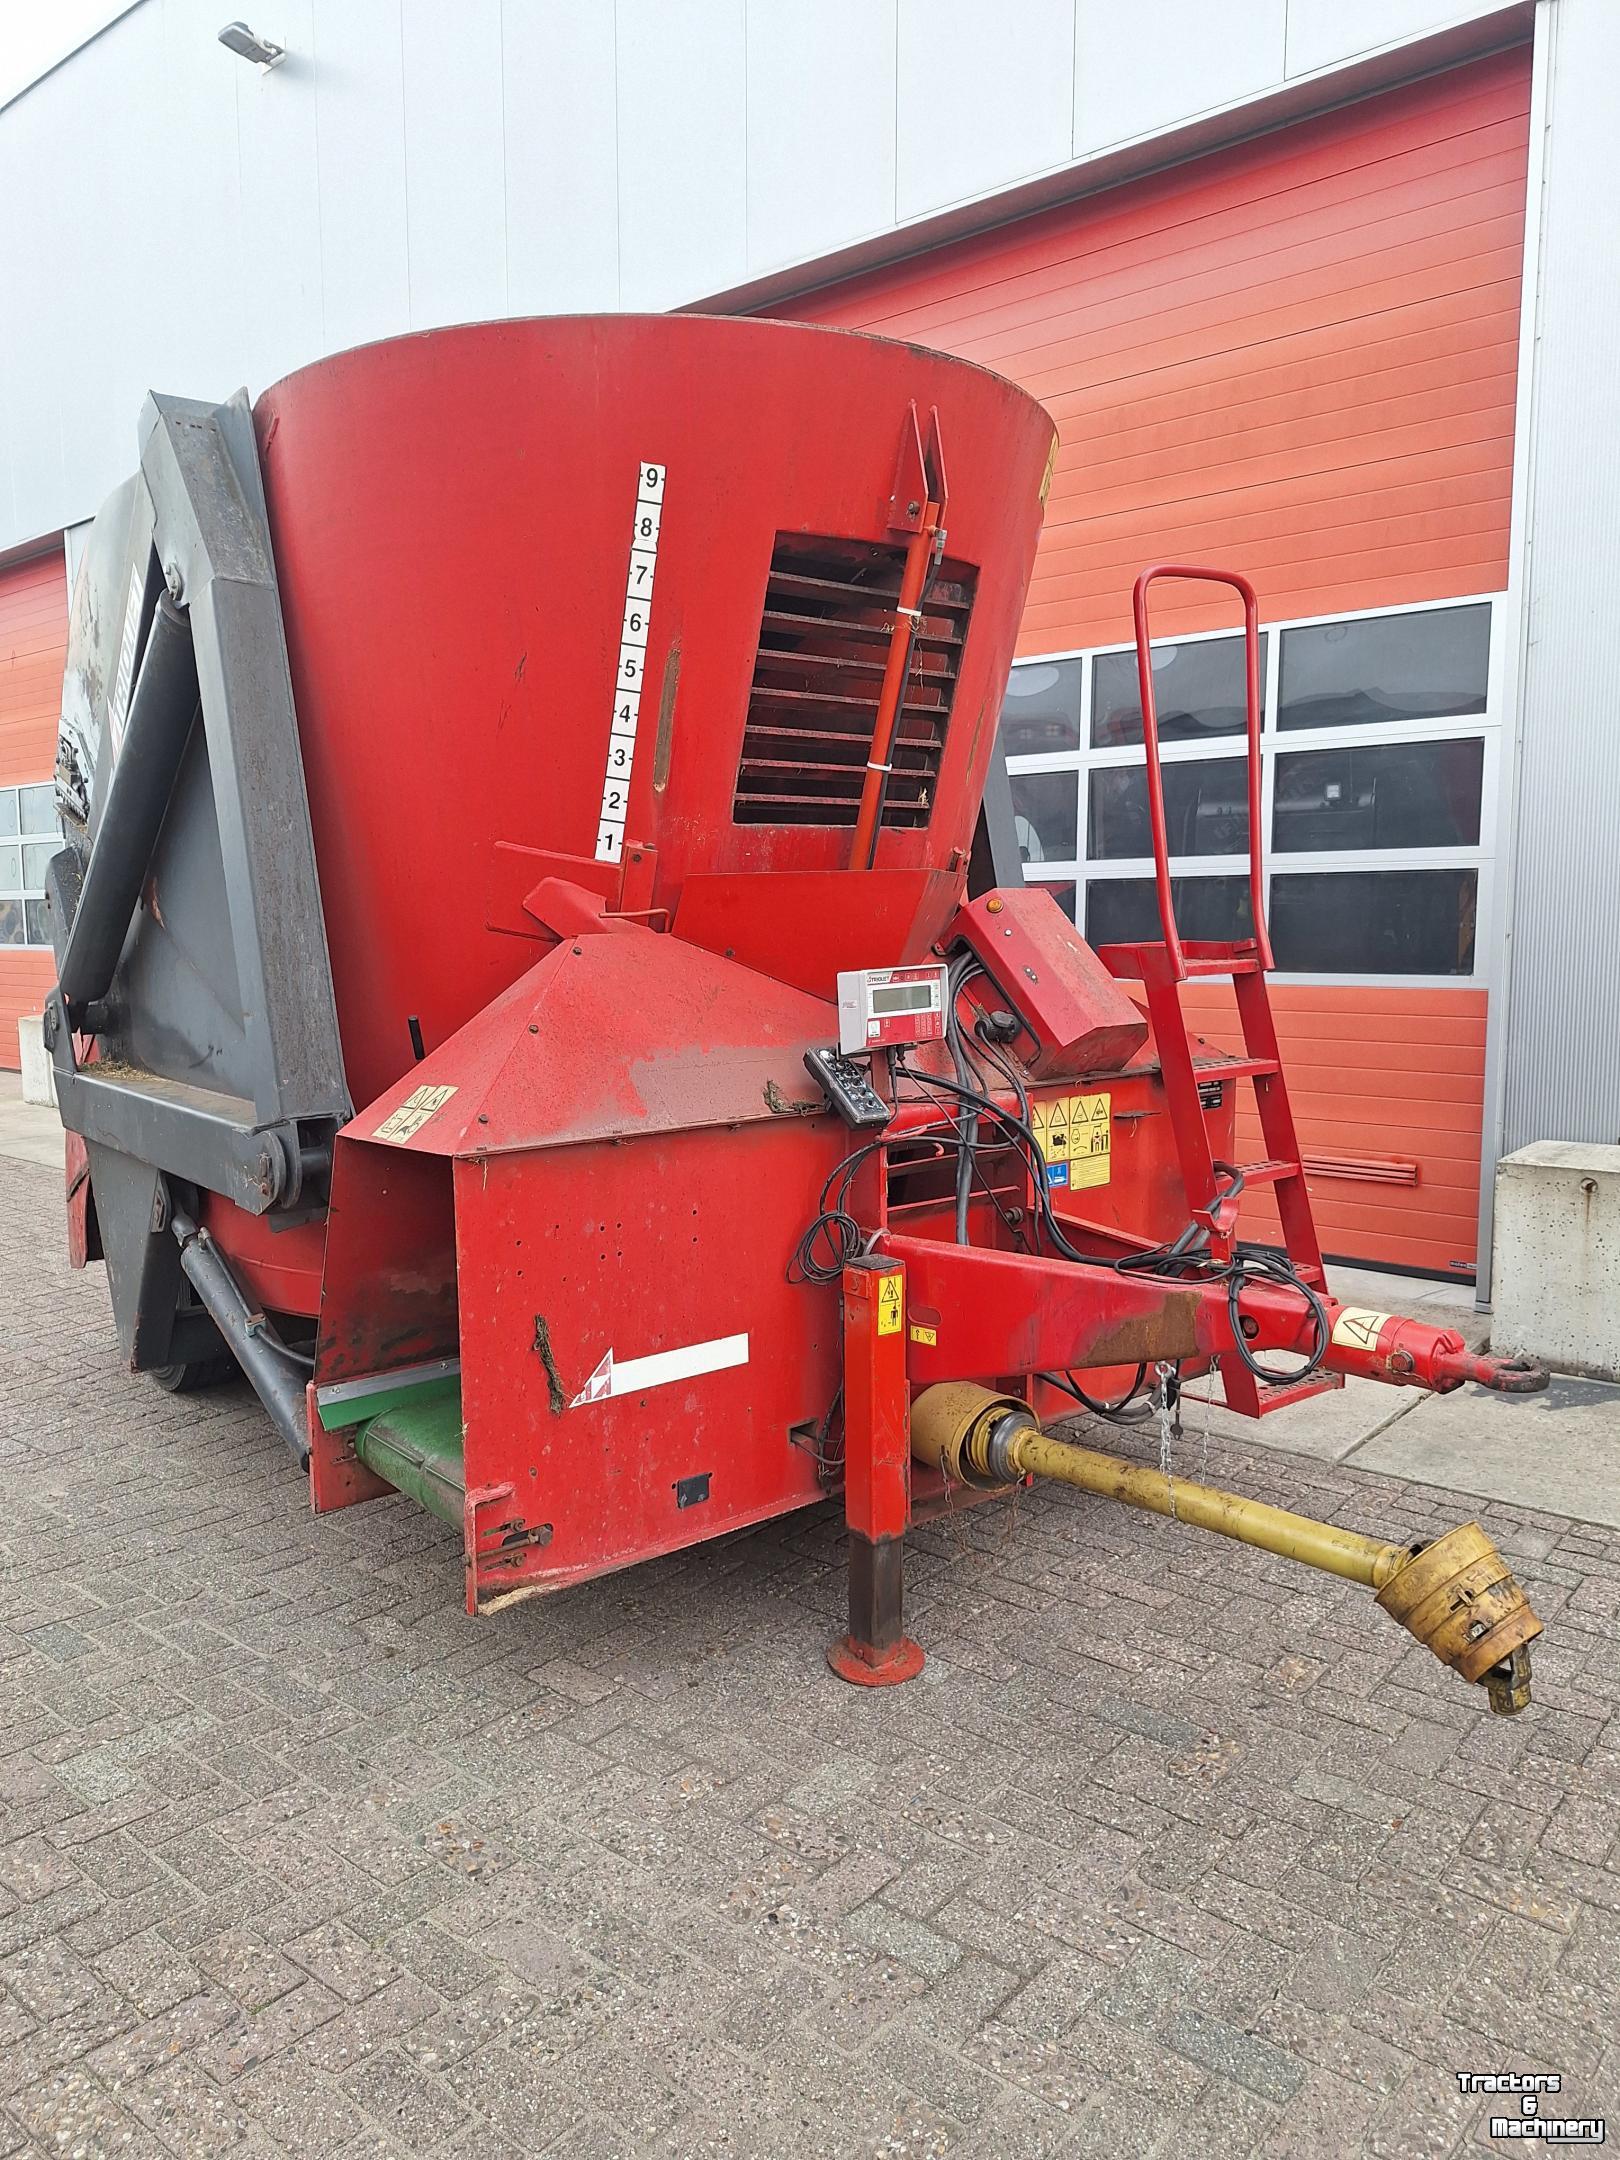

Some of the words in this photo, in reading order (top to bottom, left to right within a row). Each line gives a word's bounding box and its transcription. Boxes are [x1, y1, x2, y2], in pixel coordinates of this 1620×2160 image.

[645, 467, 659, 488] 9
[640, 517, 653, 537] 8
[635, 564, 648, 585] 7
[629, 613, 642, 632] 6
[624, 659, 637, 678] 5
[618, 704, 631, 723] 4
[613, 748, 626, 767] 3
[608, 791, 621, 810] 2
[604, 833, 613, 851] 1
